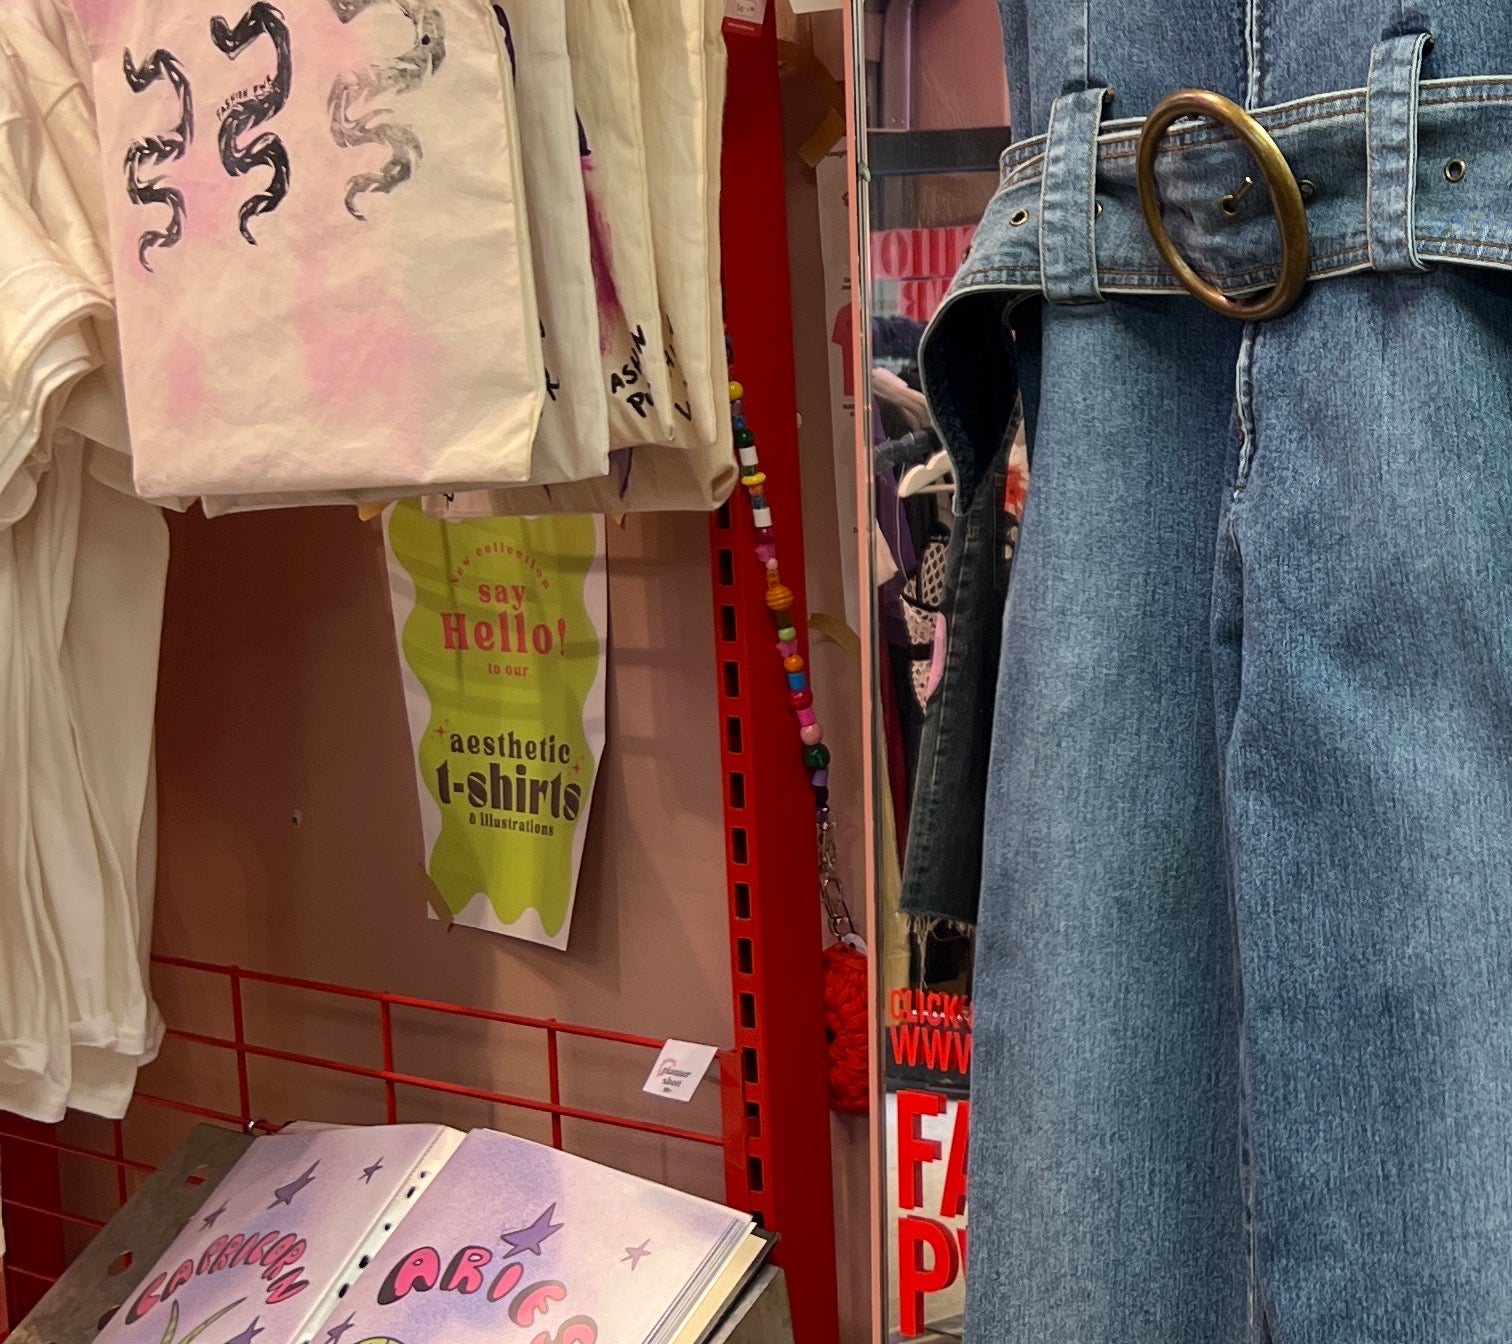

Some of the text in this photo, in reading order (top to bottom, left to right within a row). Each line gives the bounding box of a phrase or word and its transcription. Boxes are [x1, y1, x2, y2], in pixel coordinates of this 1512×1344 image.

[478, 584, 527, 611] say
[440, 610, 567, 656] Hello!
[487, 662, 529, 677] to our
[450, 730, 571, 764] aesthetic
[435, 759, 582, 821] t-shirts
[480, 812, 554, 837] illustrations
[125, 1230, 310, 1325] CAPRICORN
